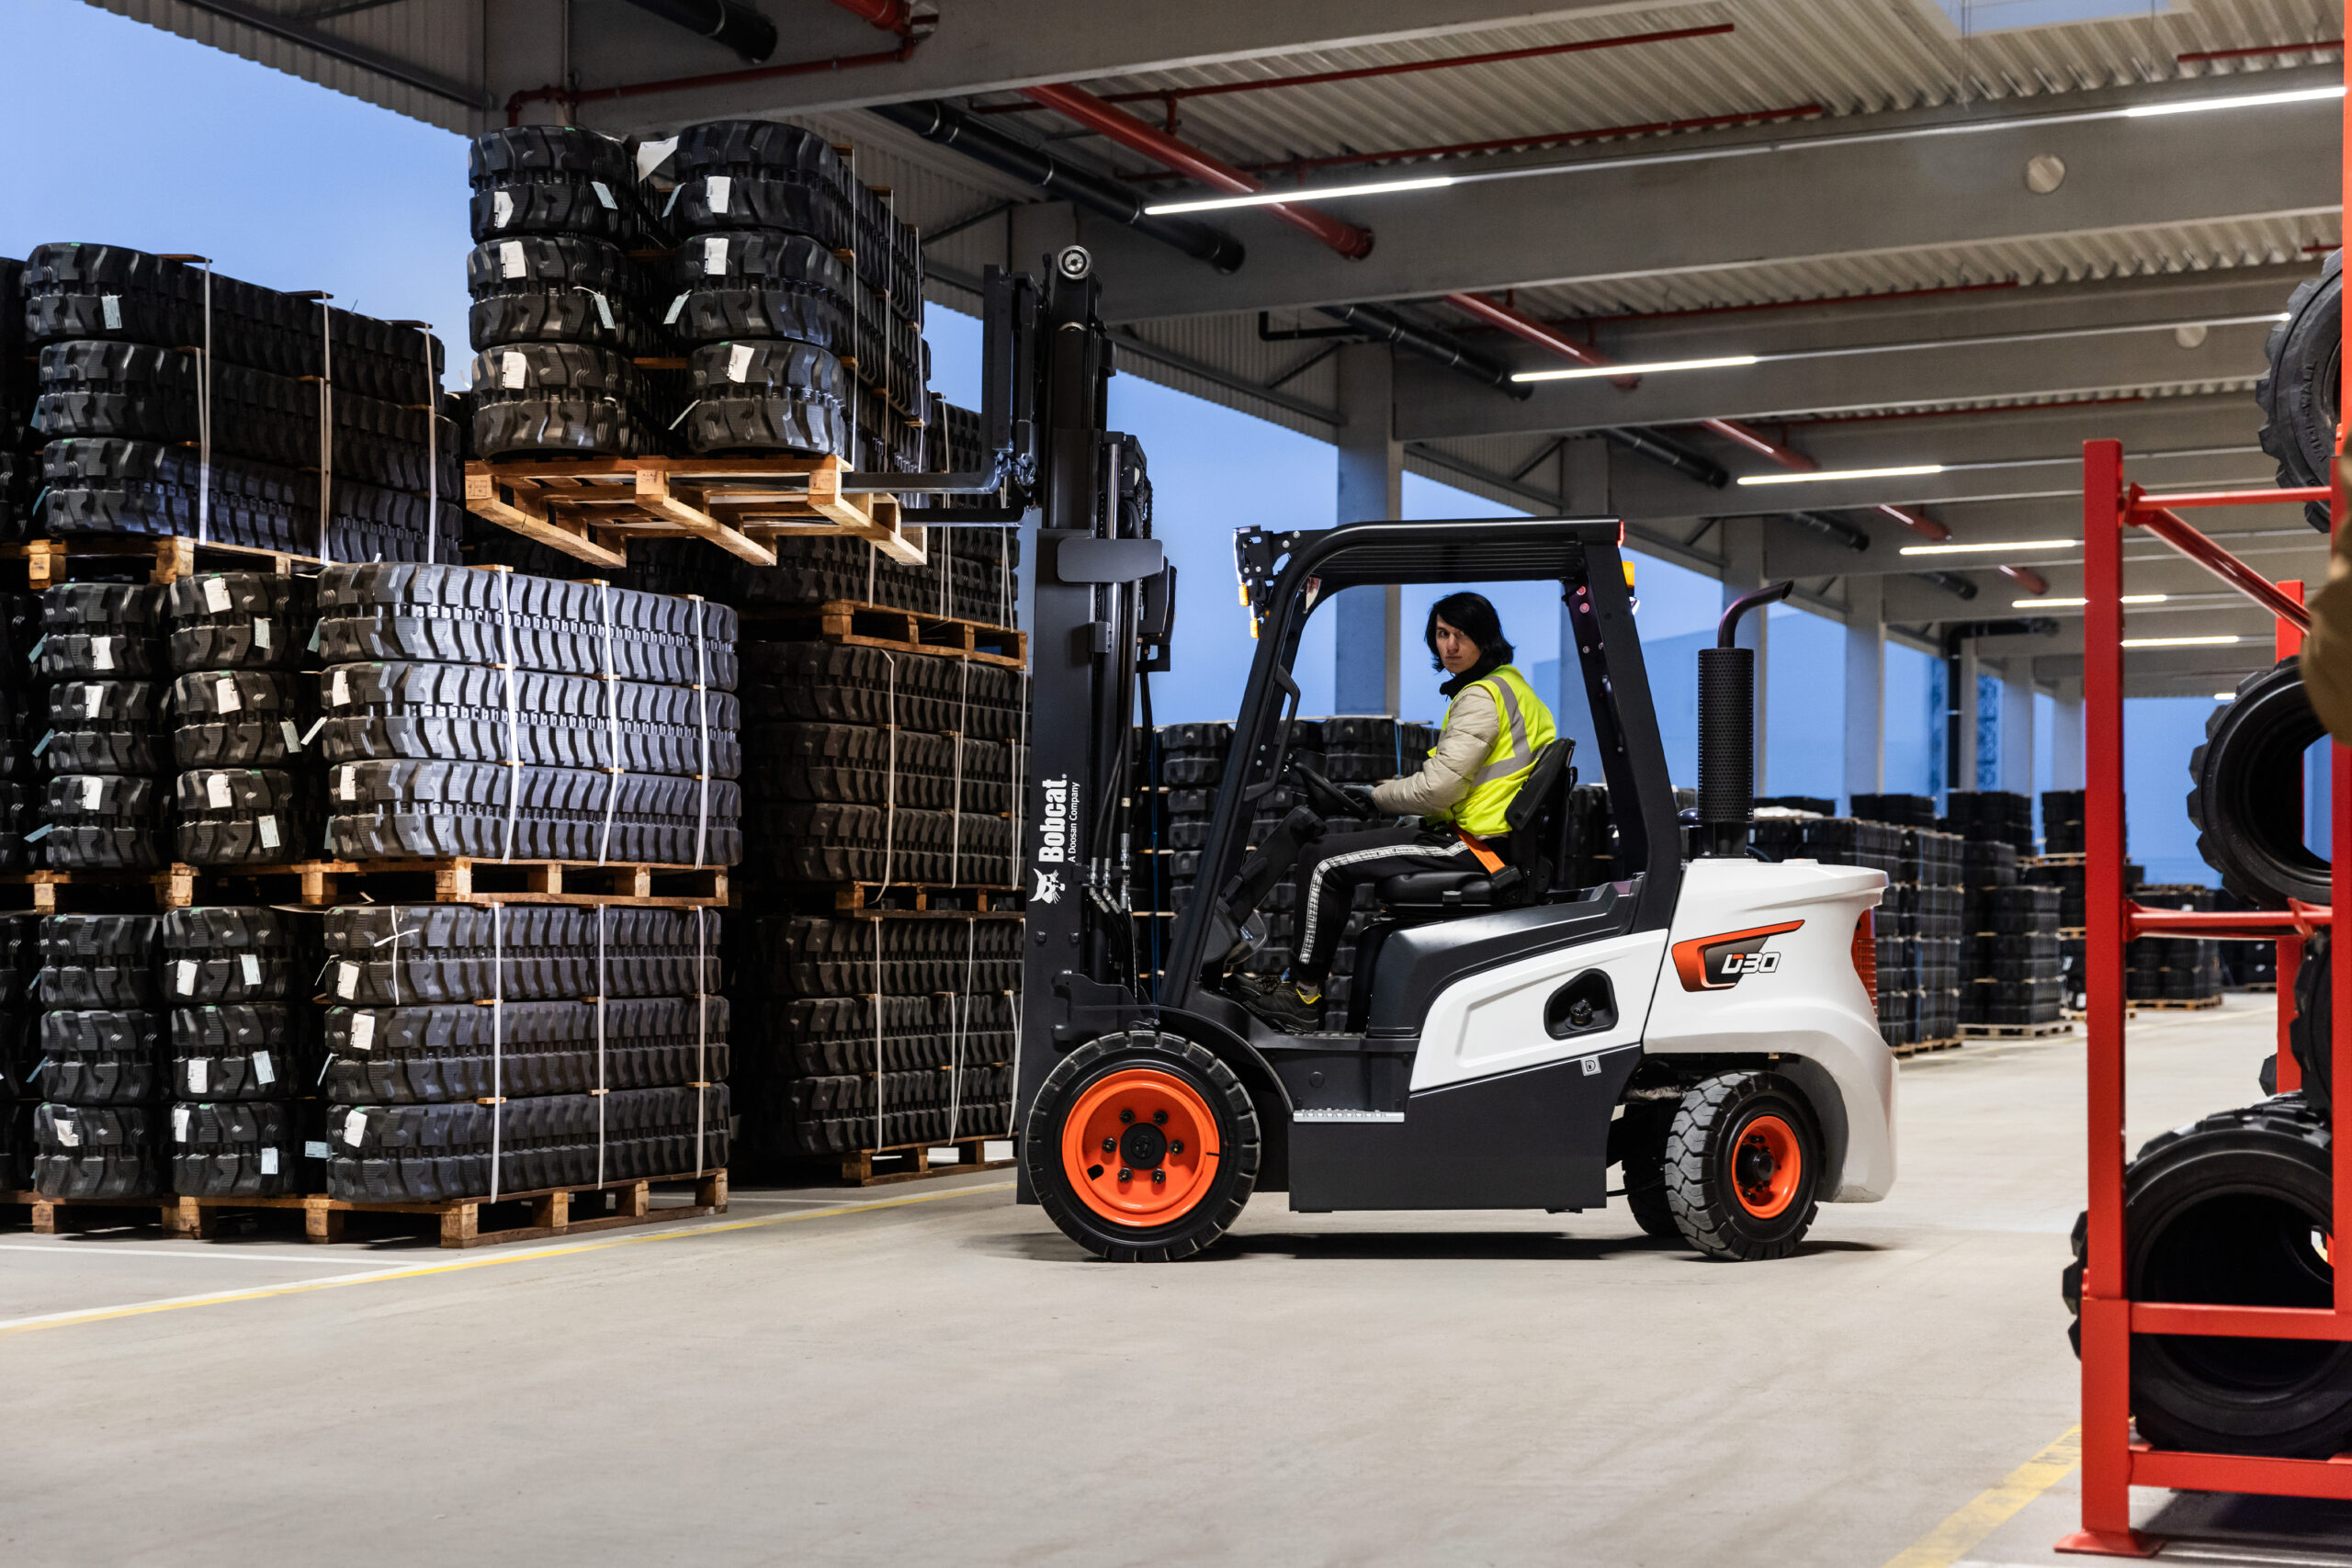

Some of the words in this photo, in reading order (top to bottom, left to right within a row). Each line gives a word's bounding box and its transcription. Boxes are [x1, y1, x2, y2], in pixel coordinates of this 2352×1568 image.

[1069, 782, 1080, 821] Company
[1038, 778, 1068, 863] Bobcat
[1068, 821, 1077, 853] Doosan
[1721, 951, 1781, 974] D30
